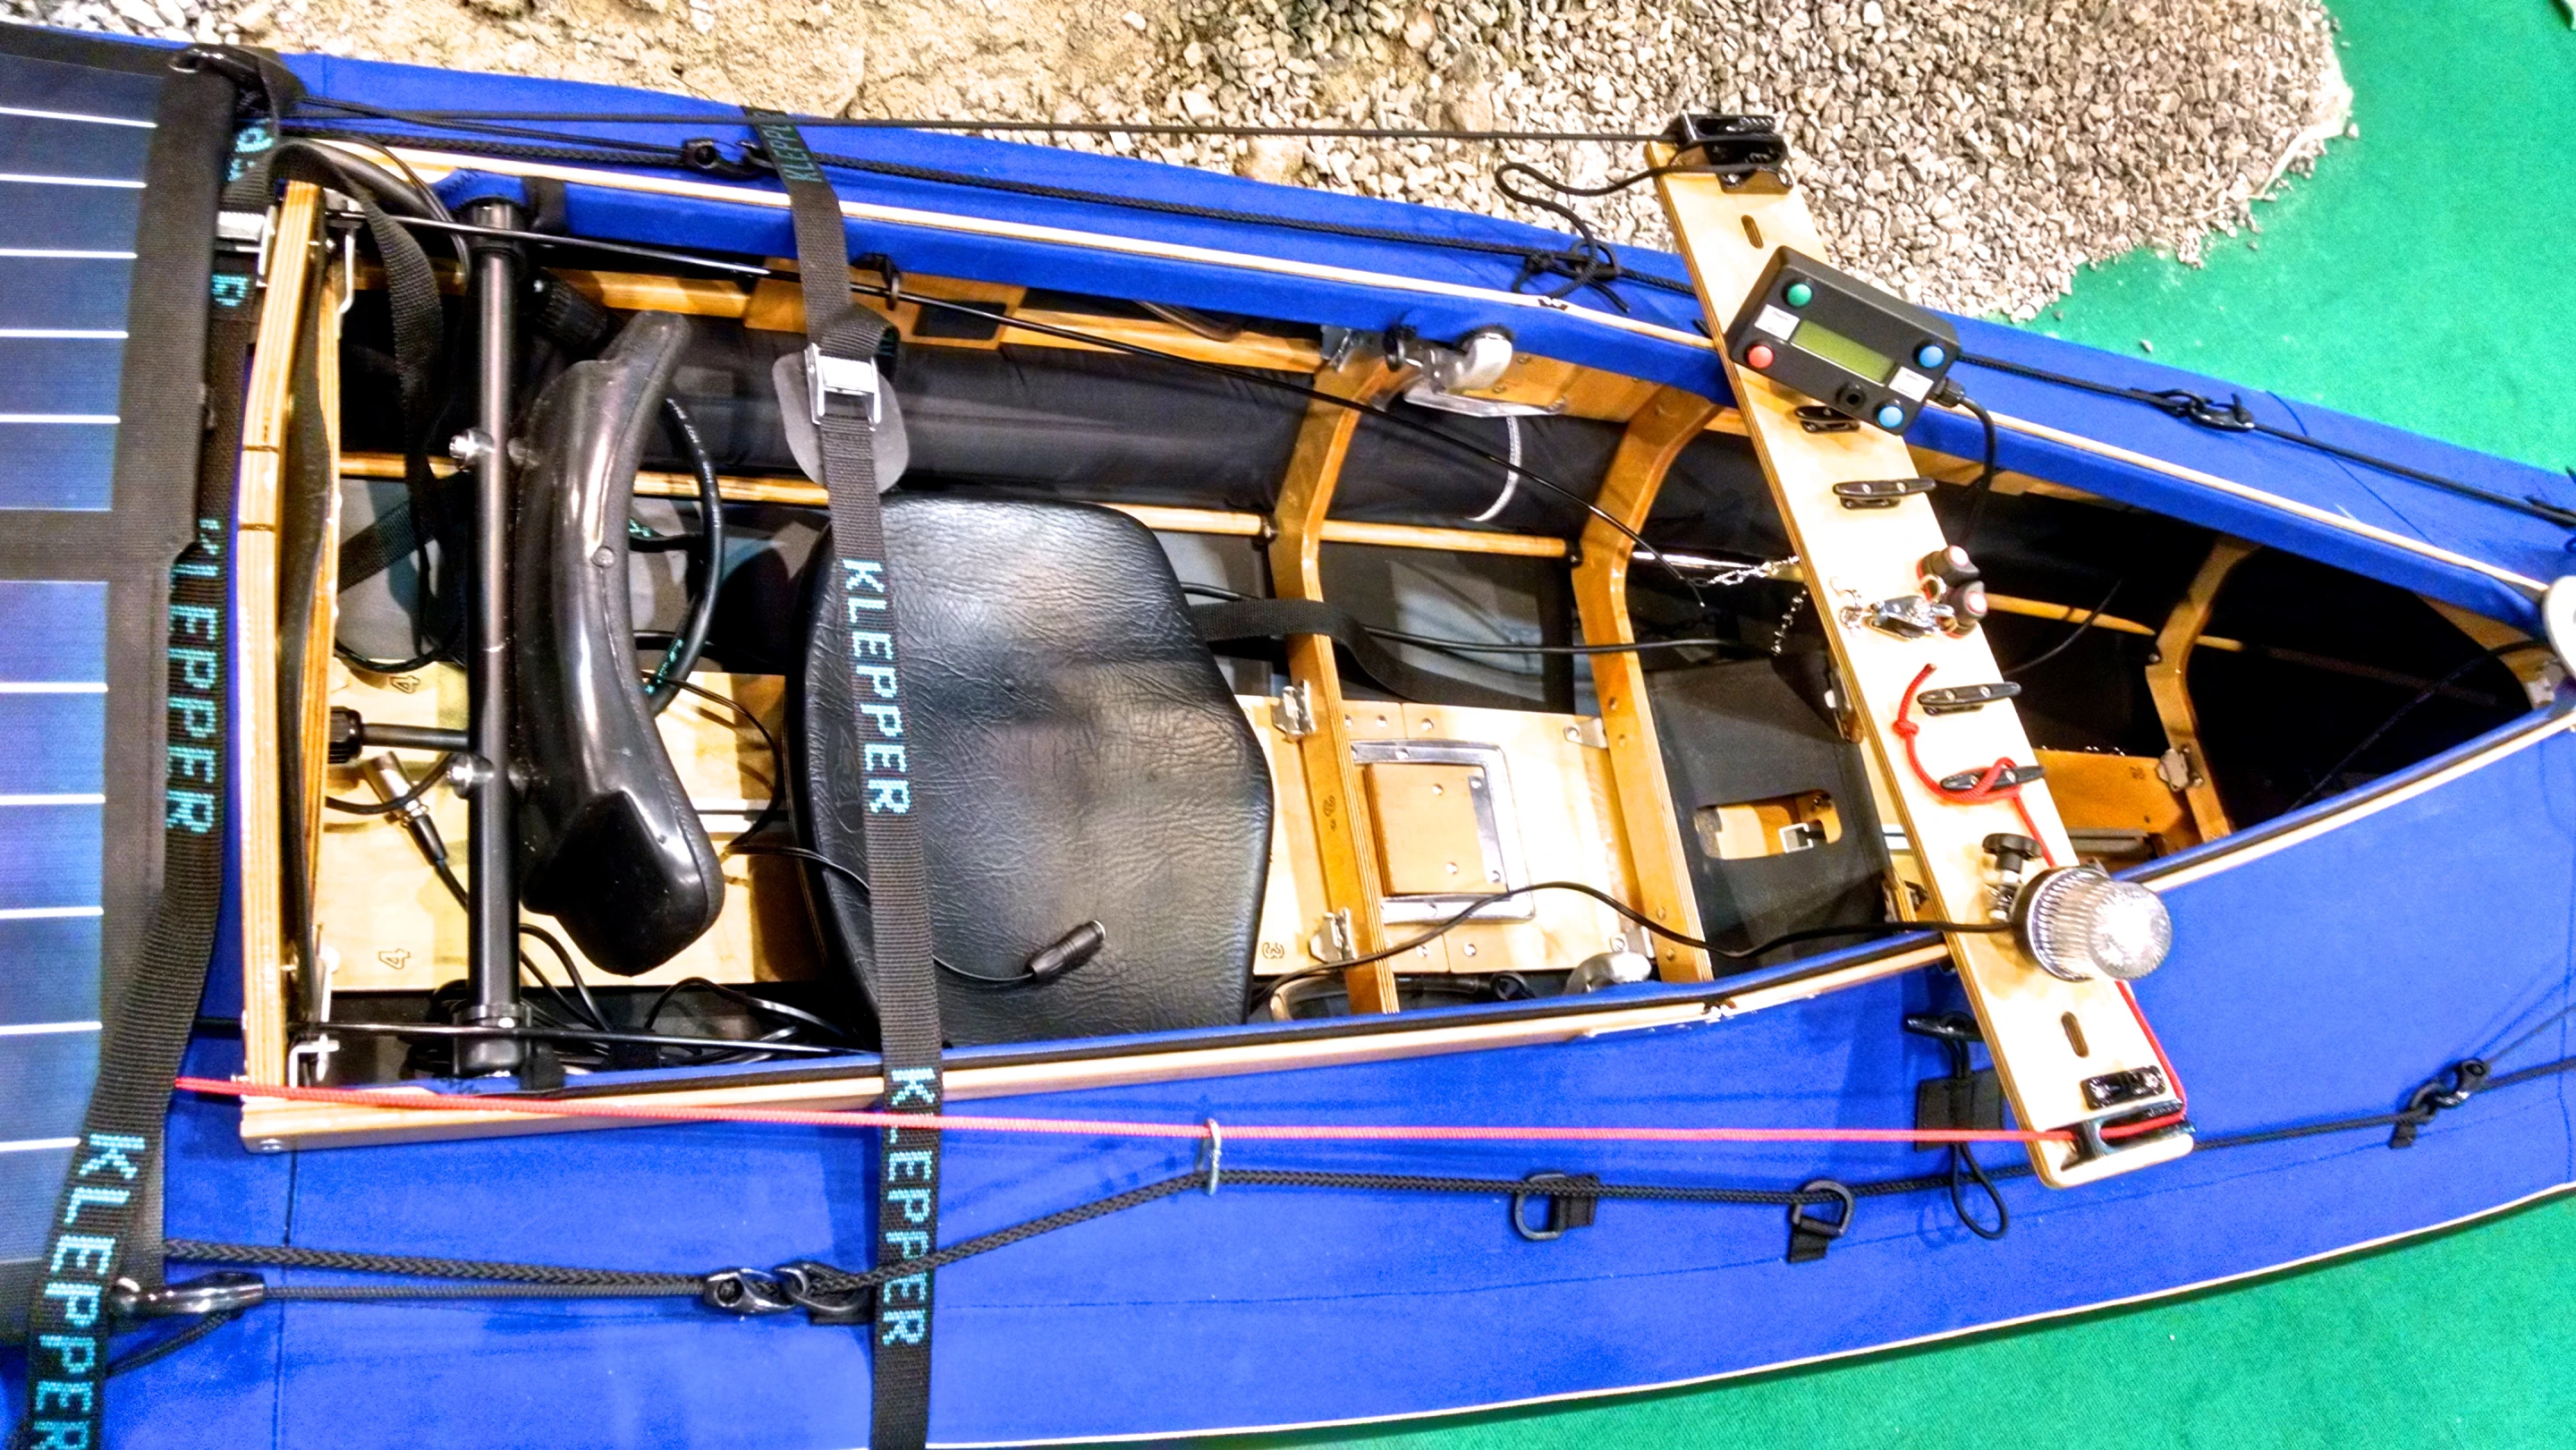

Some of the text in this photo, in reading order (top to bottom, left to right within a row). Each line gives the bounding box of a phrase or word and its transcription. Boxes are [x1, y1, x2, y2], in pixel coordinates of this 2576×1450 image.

[842, 558, 911, 814] KLEPPER
[377, 947, 411, 971] 4
[29, 1133, 146, 1450] KLEPPER
